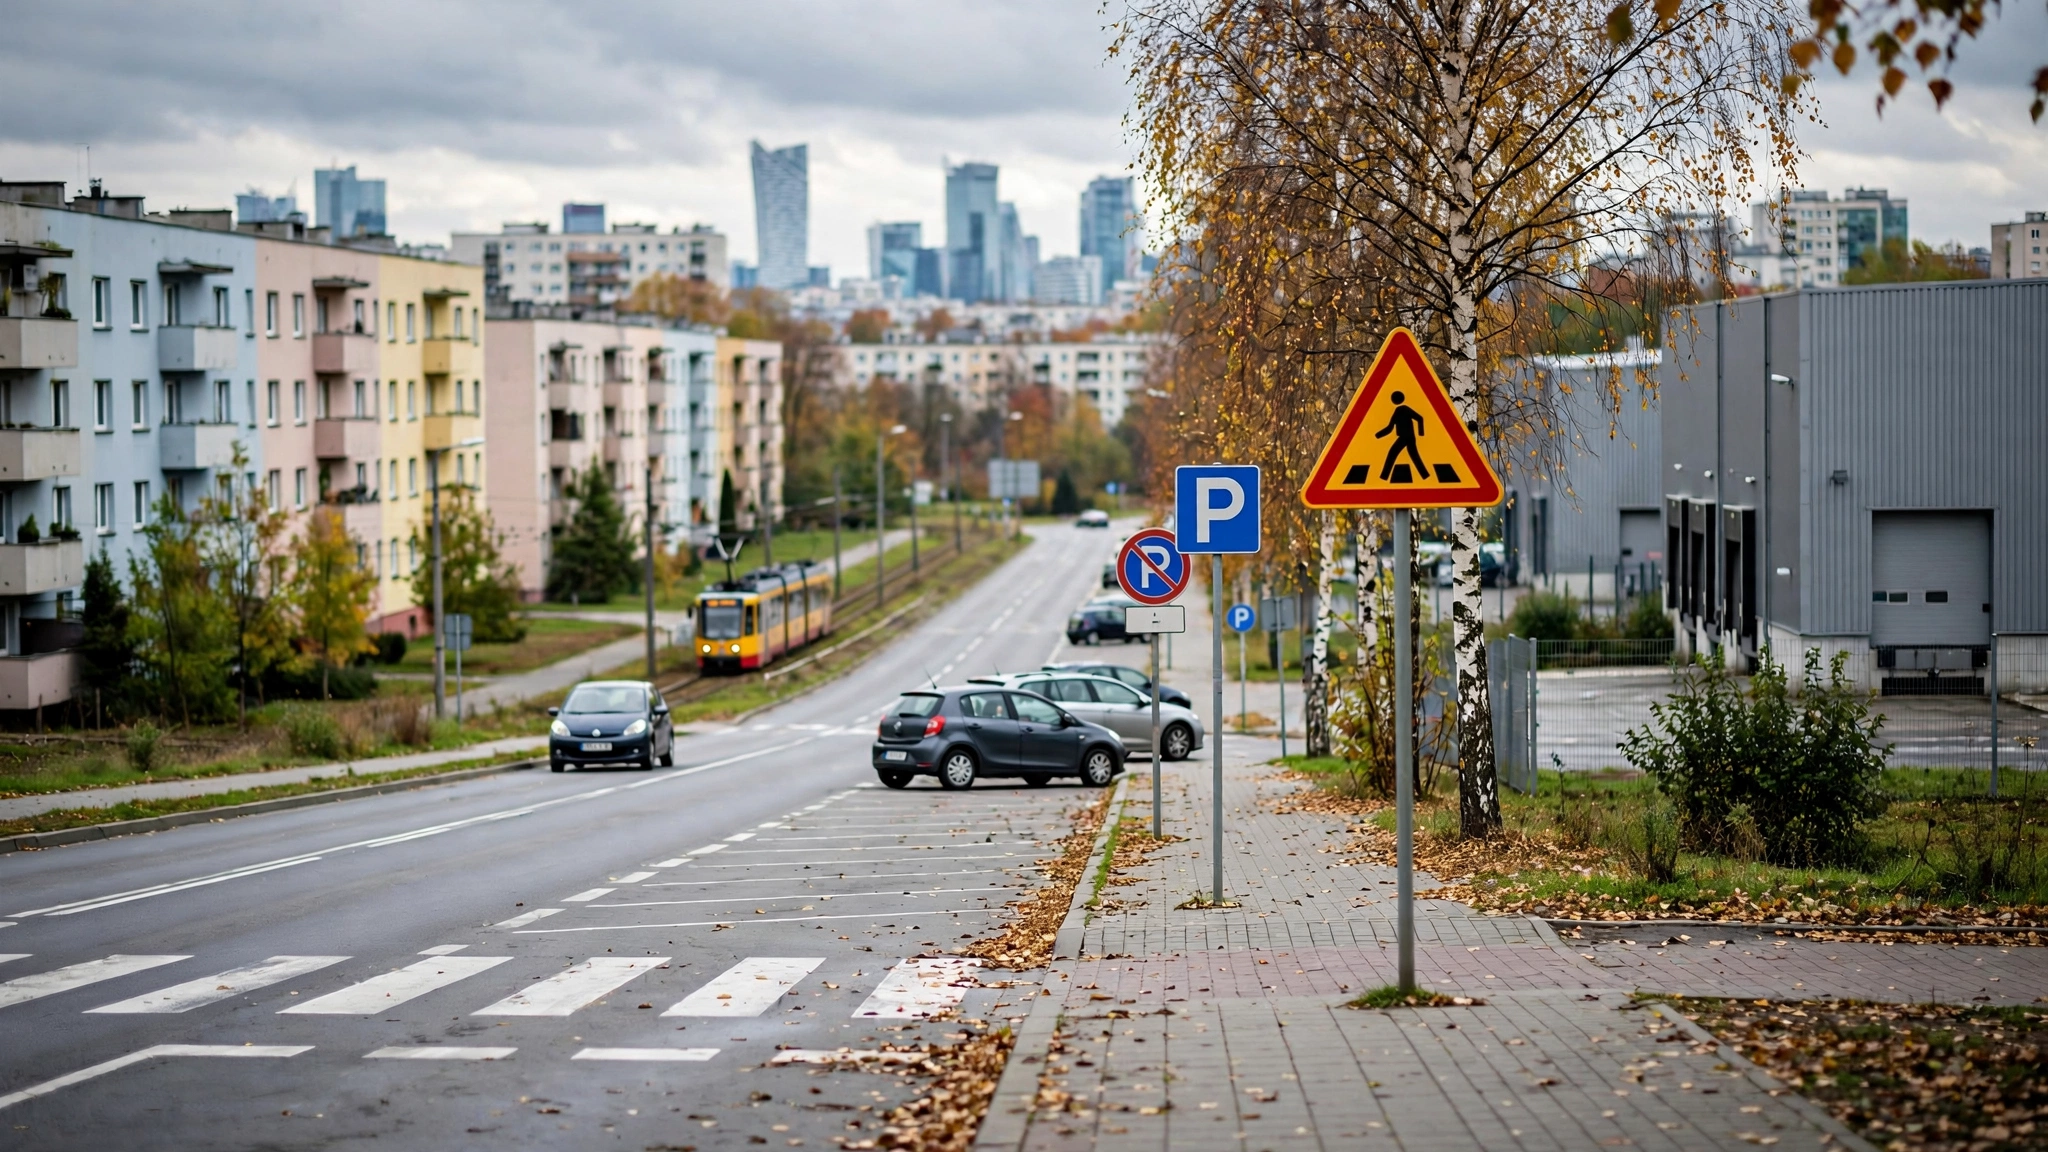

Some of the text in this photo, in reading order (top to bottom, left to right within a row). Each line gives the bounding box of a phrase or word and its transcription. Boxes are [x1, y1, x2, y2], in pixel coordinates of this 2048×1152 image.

[1196, 477, 1245, 543] P
[1141, 545, 1171, 588] P
[1234, 607, 1250, 628] P
